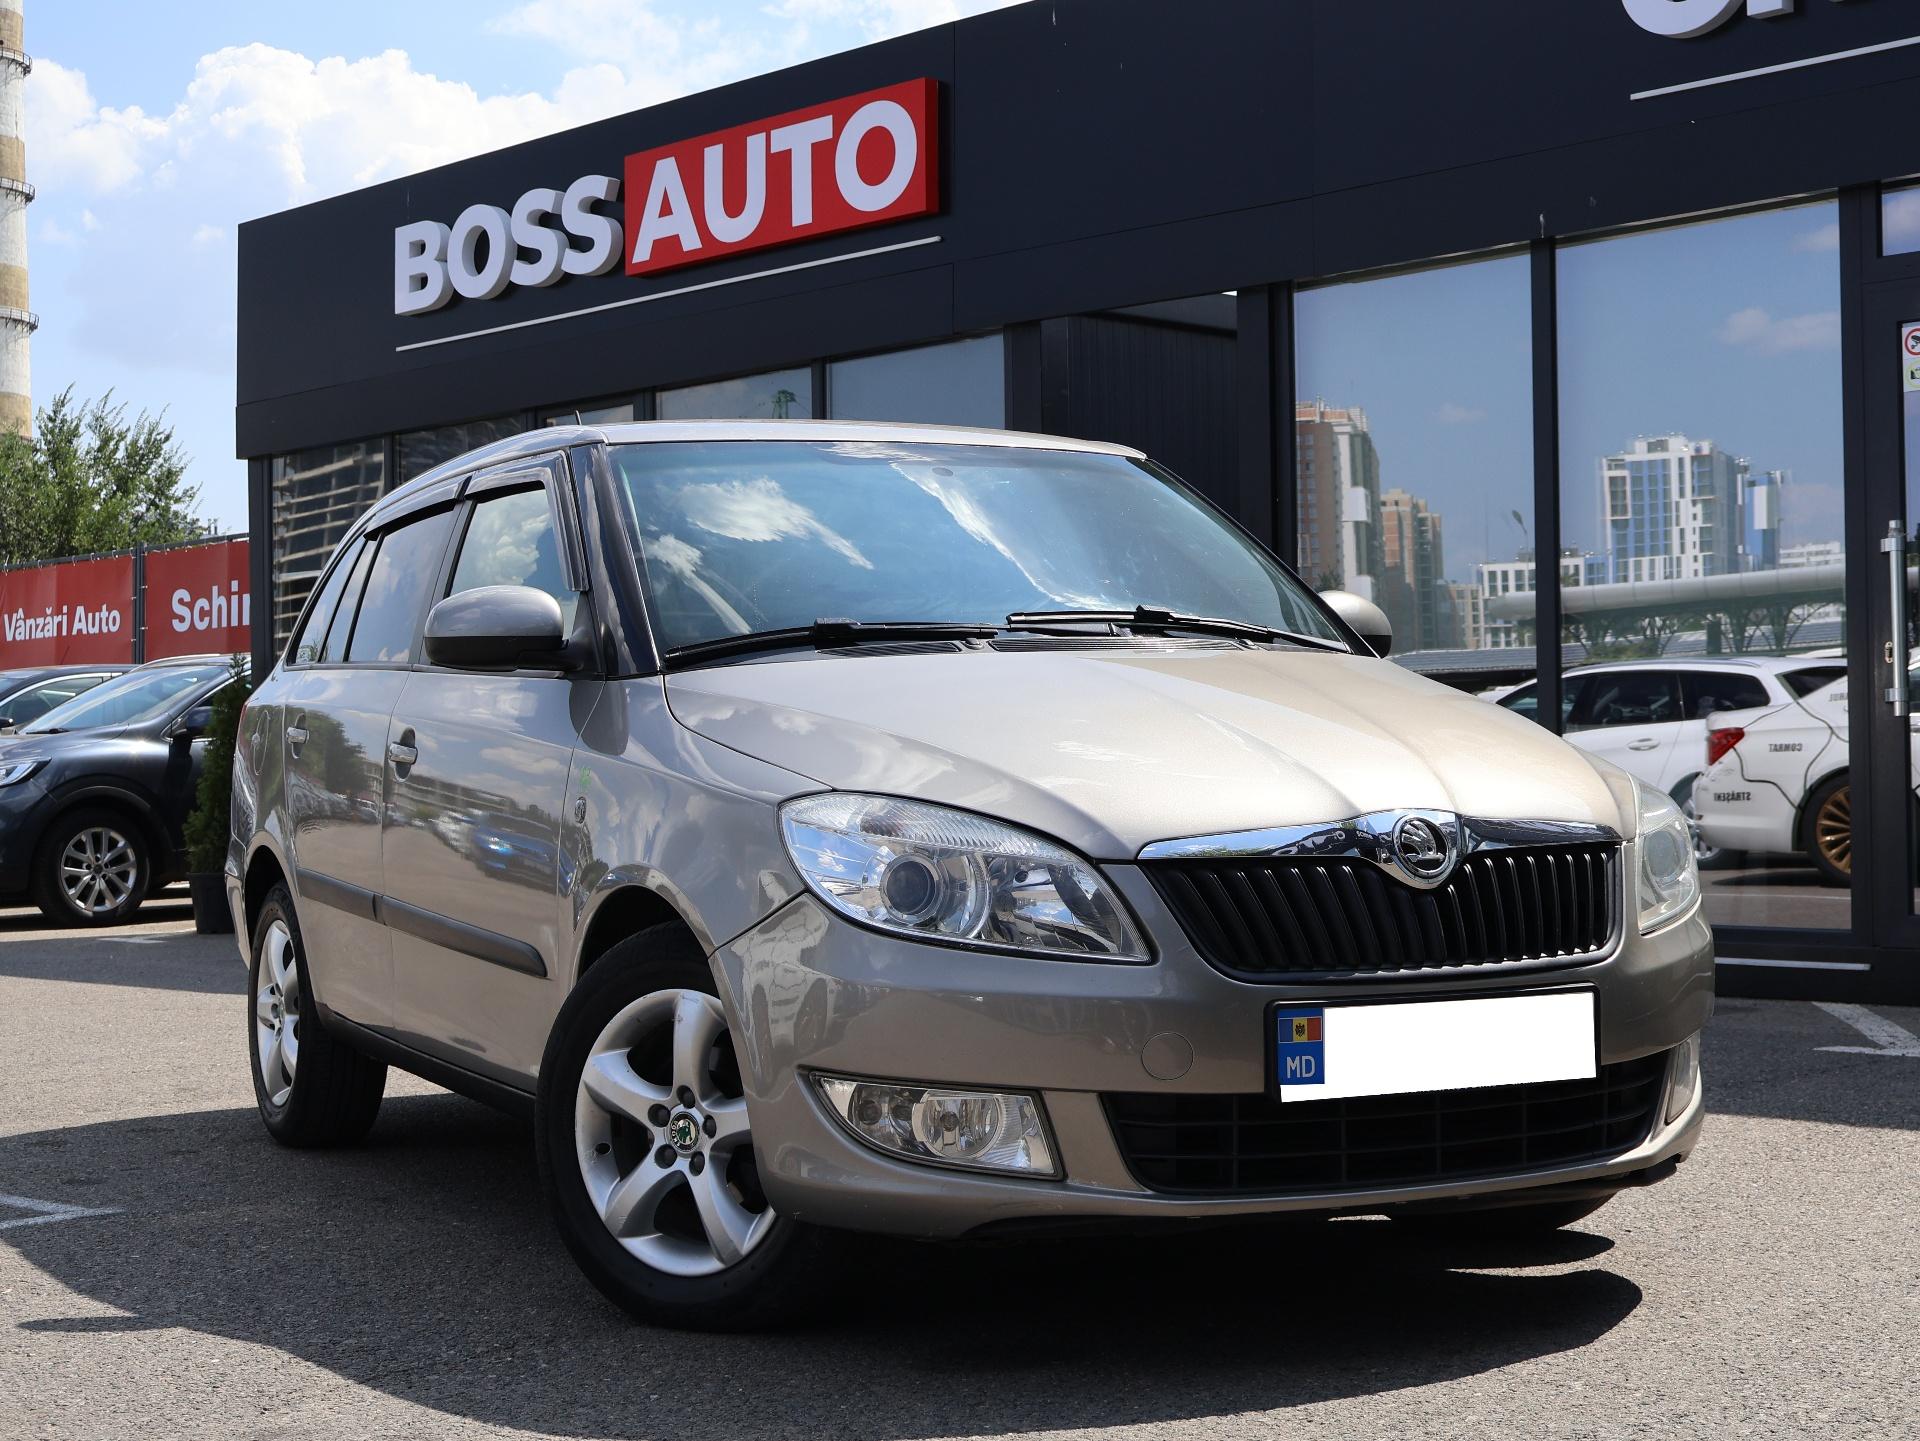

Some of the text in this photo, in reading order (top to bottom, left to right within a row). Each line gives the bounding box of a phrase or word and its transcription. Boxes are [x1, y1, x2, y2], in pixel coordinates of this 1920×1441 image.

[394, 99, 918, 317] BOSS AUTO
[4, 604, 121, 642] Vânzări Auto
[1286, 1055, 1316, 1079] MD
